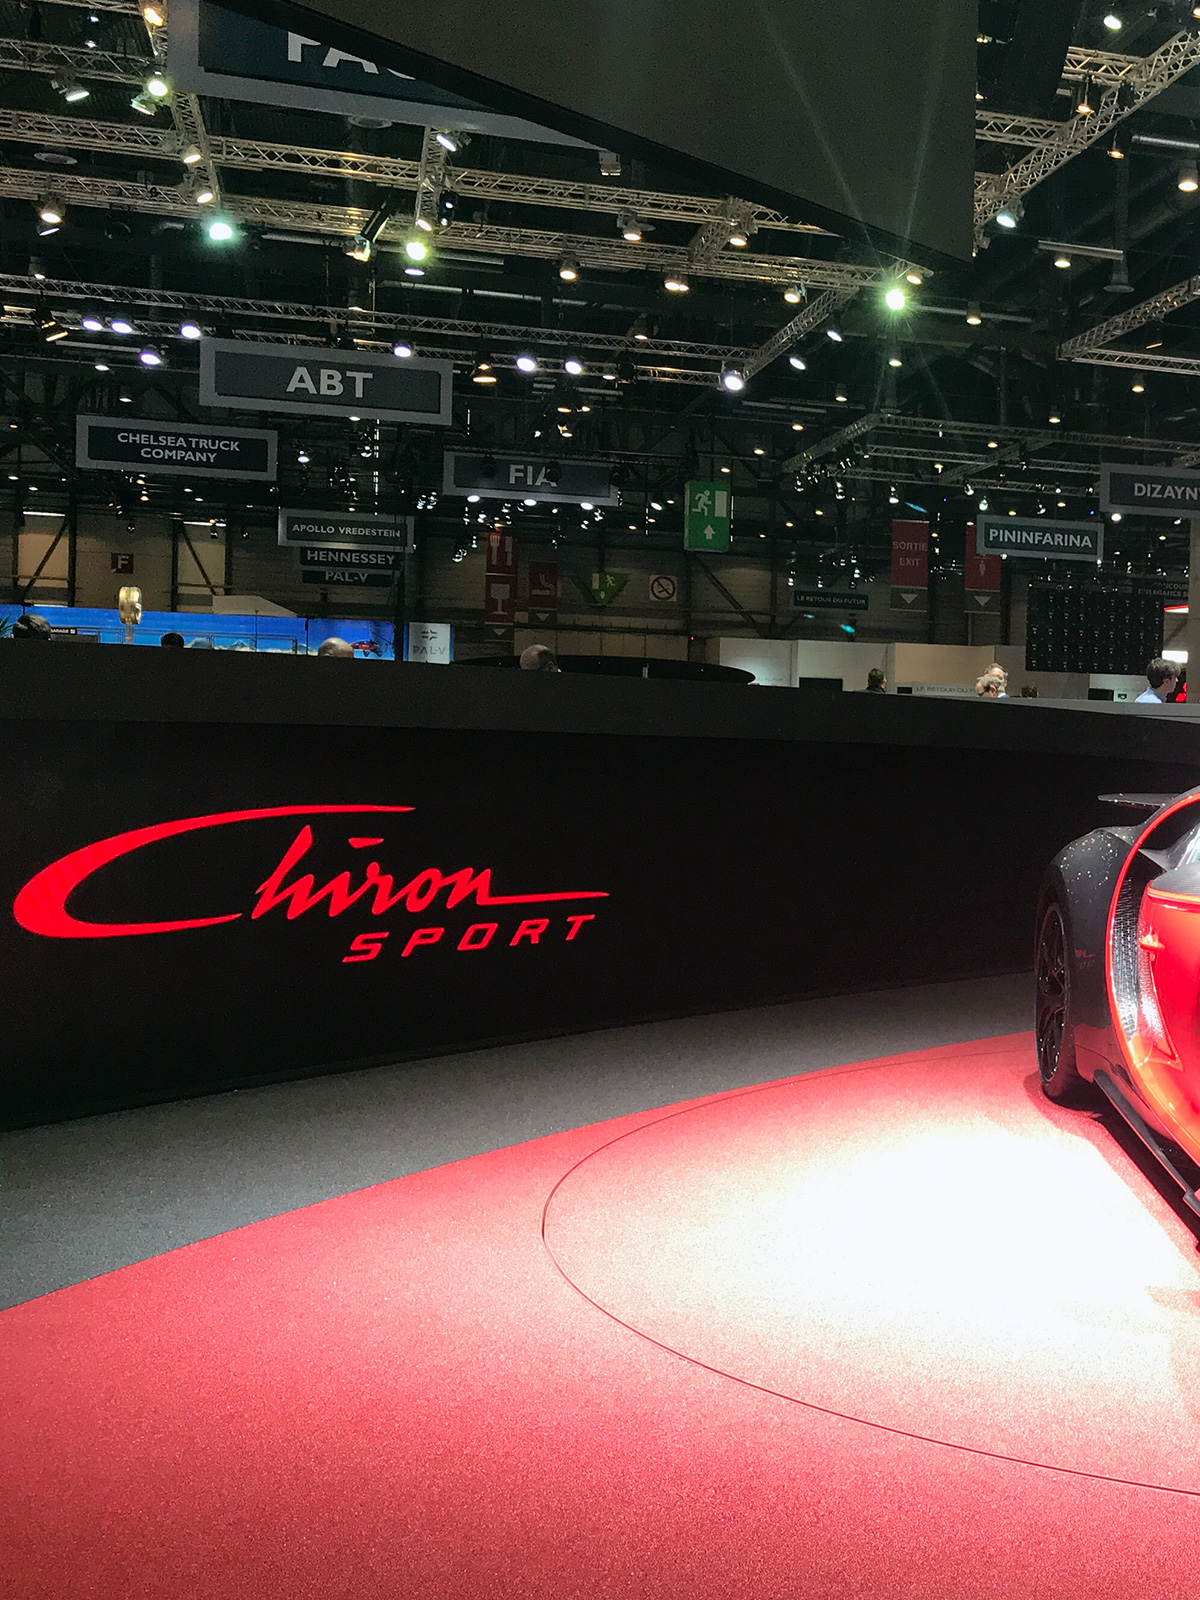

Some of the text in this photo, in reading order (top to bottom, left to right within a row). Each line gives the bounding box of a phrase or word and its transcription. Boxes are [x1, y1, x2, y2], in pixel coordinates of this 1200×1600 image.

[286, 366, 374, 399] ABT
[117, 432, 240, 452] CHELSEA TRUCK
[140, 448, 217, 463] COMPANY
[509, 464, 557, 487] FIA
[292, 524, 401, 538] APOLLO VREDESTEIN
[989, 528, 1093, 549] PININFARINA
[893, 541, 928, 552] SORTIE
[118, 555, 129, 569] F
[307, 550, 395, 565] HENNESSEY
[900, 557, 920, 566] EXIT
[325, 571, 368, 583] PAL-V
[412, 645, 446, 655] PAL-V
[13, 804, 610, 938] Chiron
[343, 914, 596, 963] SPORT
